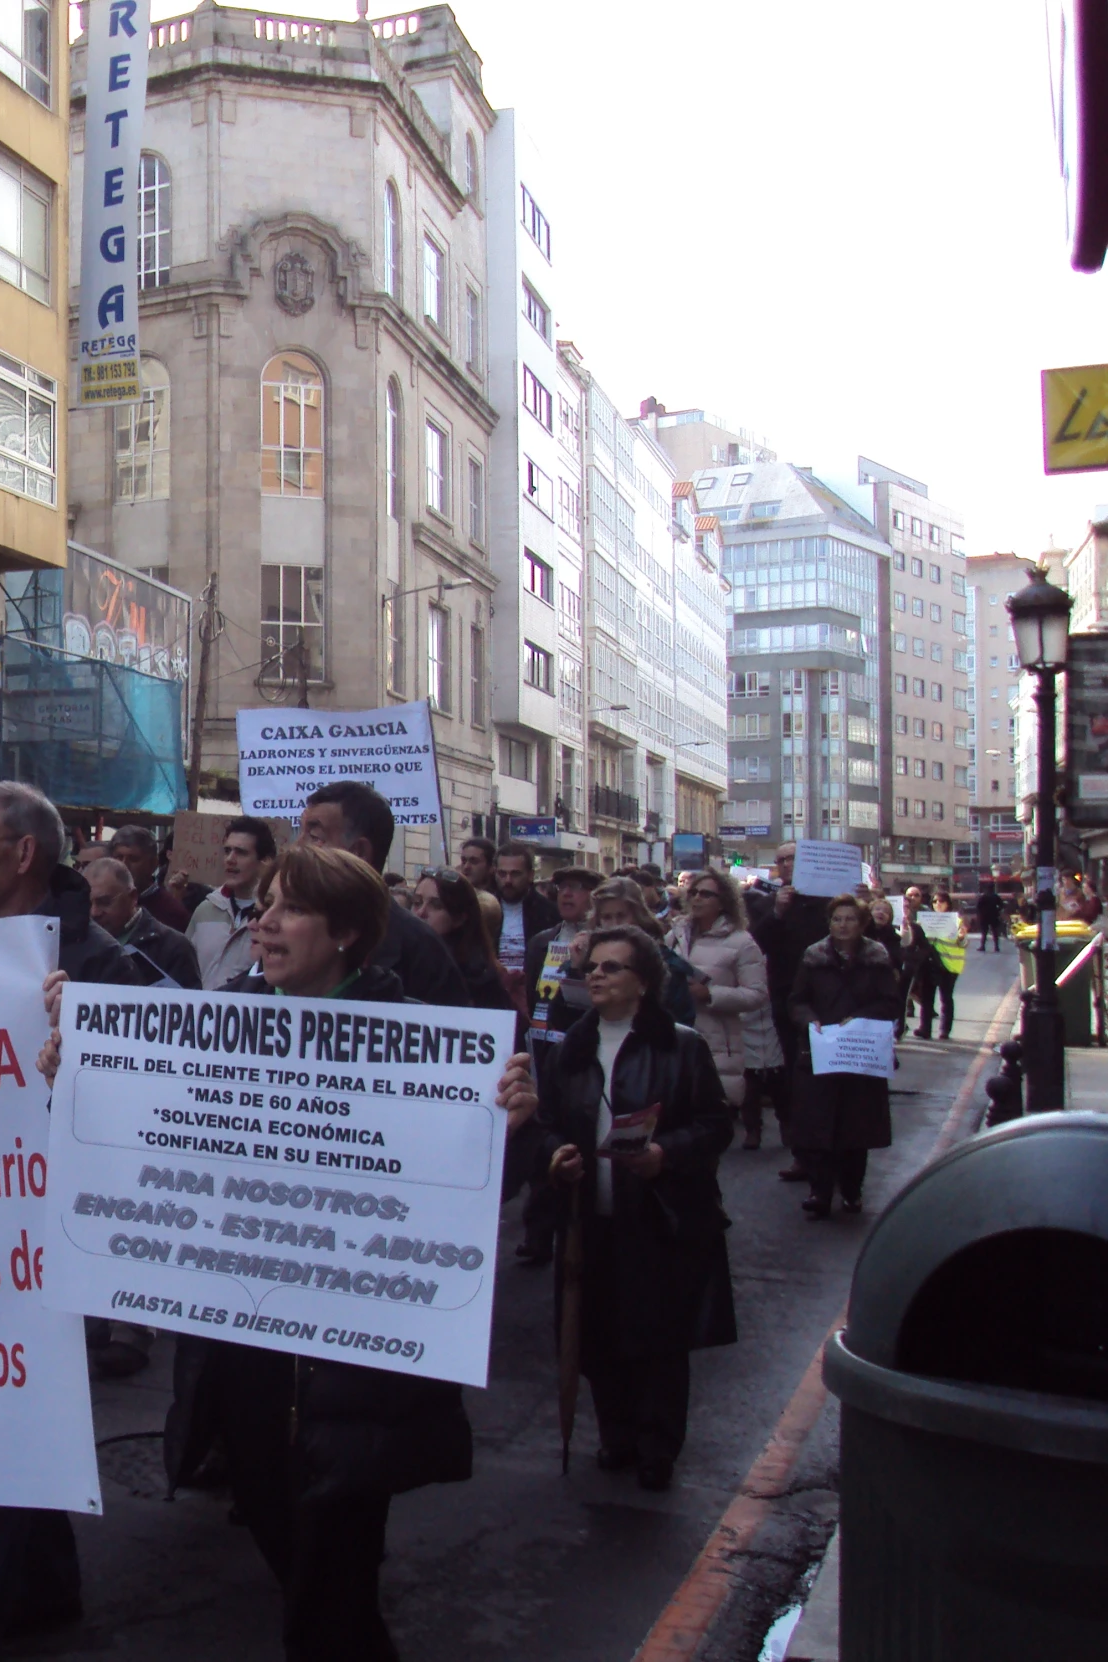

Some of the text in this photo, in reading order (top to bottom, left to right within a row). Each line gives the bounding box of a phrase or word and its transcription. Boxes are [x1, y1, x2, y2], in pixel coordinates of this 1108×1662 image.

[97, 0, 138, 329] RETEGA
[82, 334, 135, 353] RETEGA
[97, 365, 108, 380] 981
[111, 363, 121, 378] 153
[123, 362, 135, 377] 792
[84, 385, 136, 400] www.retega.es
[261, 721, 408, 740] CAIXA GALICIA
[240, 744, 429, 760] LADRONES Y SINVERGÜENZAS
[247, 762, 422, 776] DEANNOS EL DINERO QUE
[295, 782, 324, 791] NOS
[253, 797, 419, 809] CELULA NTES
[394, 814, 437, 824] ENTES
[75, 1003, 496, 1065] PARTICIPACIONES PREFERENTES
[80, 1053, 480, 1103] PERFIL DEL CLIENTE TIPO PARA EL BANCO:
[239, 1090, 263, 1107] DE
[269, 1092, 292, 1110] 60
[296, 1094, 351, 1116] AÑOS
[268, 1119, 386, 1147] ECONÓMICA
[252, 1142, 278, 1160] EN
[283, 1146, 310, 1165] SU
[315, 1151, 402, 1175] ENTIDAD
[137, 1164, 411, 1223] PARA NOSOTROS:
[72, 1191, 198, 1231] ENGAÑO
[220, 1212, 337, 1253] ESTAFA
[362, 1232, 485, 1273] ABUSO
[107, 1231, 440, 1306] CON PREMEDITACIÓN
[110, 1290, 425, 1363] (HASTA LES DIERON CURSOS)
